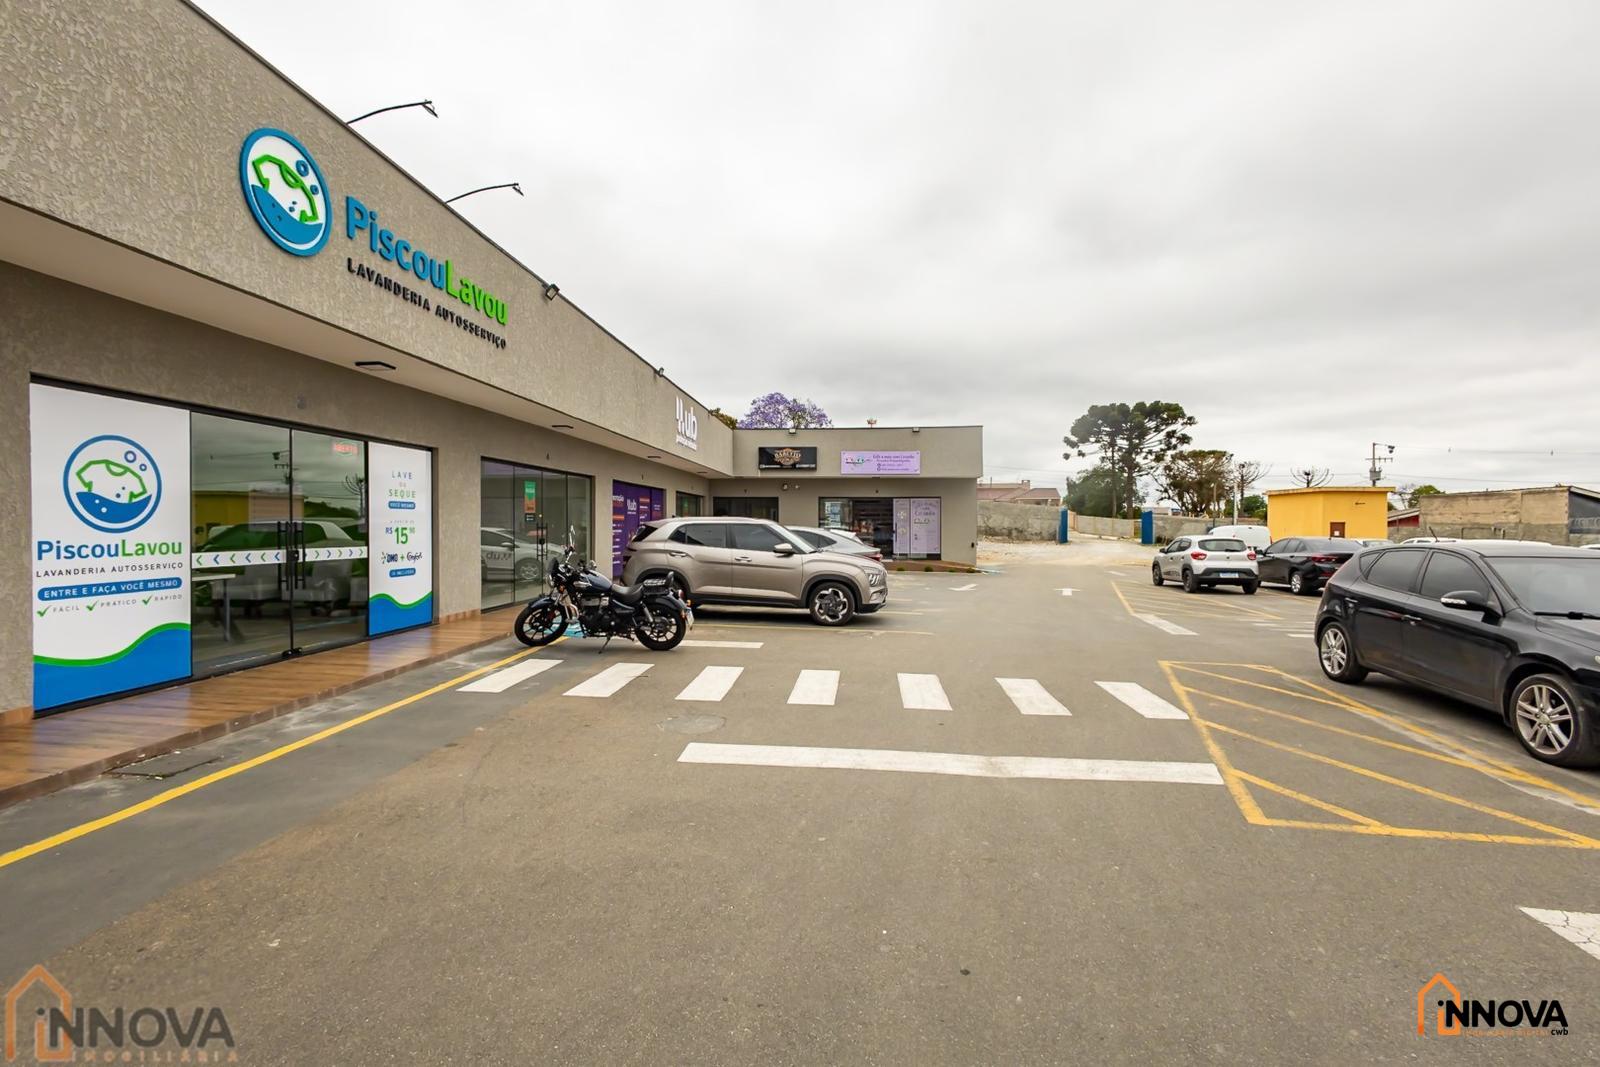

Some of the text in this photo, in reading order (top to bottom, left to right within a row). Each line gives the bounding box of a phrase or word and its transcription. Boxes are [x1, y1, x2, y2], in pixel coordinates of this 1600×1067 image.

[345, 196, 508, 325] PiscouLavou
[347, 257, 507, 350] LAVANDERIA AUTOSSERVIÇO
[392, 470, 413, 480] LAVE
[394, 526, 409, 545] 15
[37, 539, 182, 560] PiscouLavou
[36, 561, 184, 577] LAVANDERIA AUTOSSERVIÇO
[44, 578, 178, 598] ENTRE E FAÇA VOCÊ MESMO
